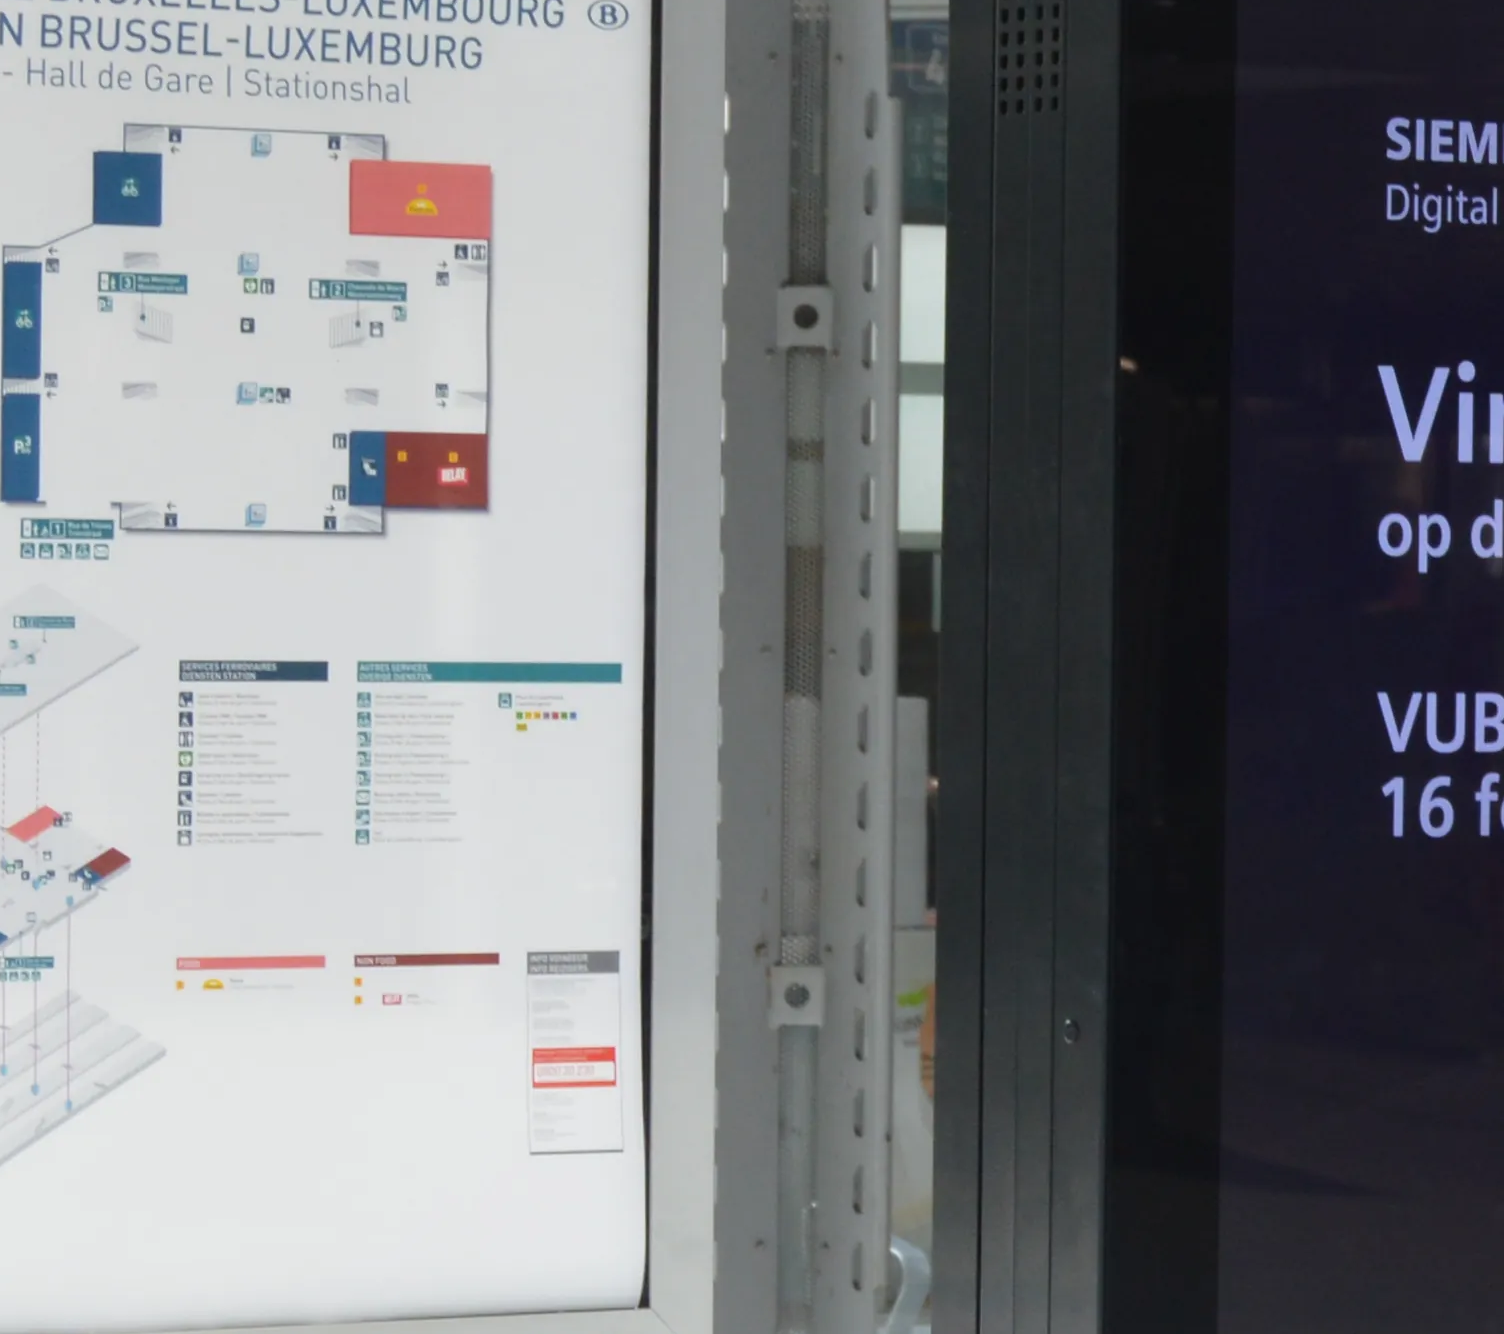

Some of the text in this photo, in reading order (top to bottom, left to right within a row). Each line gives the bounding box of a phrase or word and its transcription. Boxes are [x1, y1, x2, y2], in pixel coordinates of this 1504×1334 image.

[39, 14, 484, 69] BRUSSEL-LUXEMBURG
[26, 57, 87, 88] Hall
[98, 62, 133, 92] de
[144, 63, 214, 94] Gare
[243, 68, 412, 105] Stationshal
[1385, 183, 1498, 234] Digital
[1377, 510, 1452, 573] op
[181, 661, 220, 672] SERVICES
[1381, 775, 1455, 839] 16
